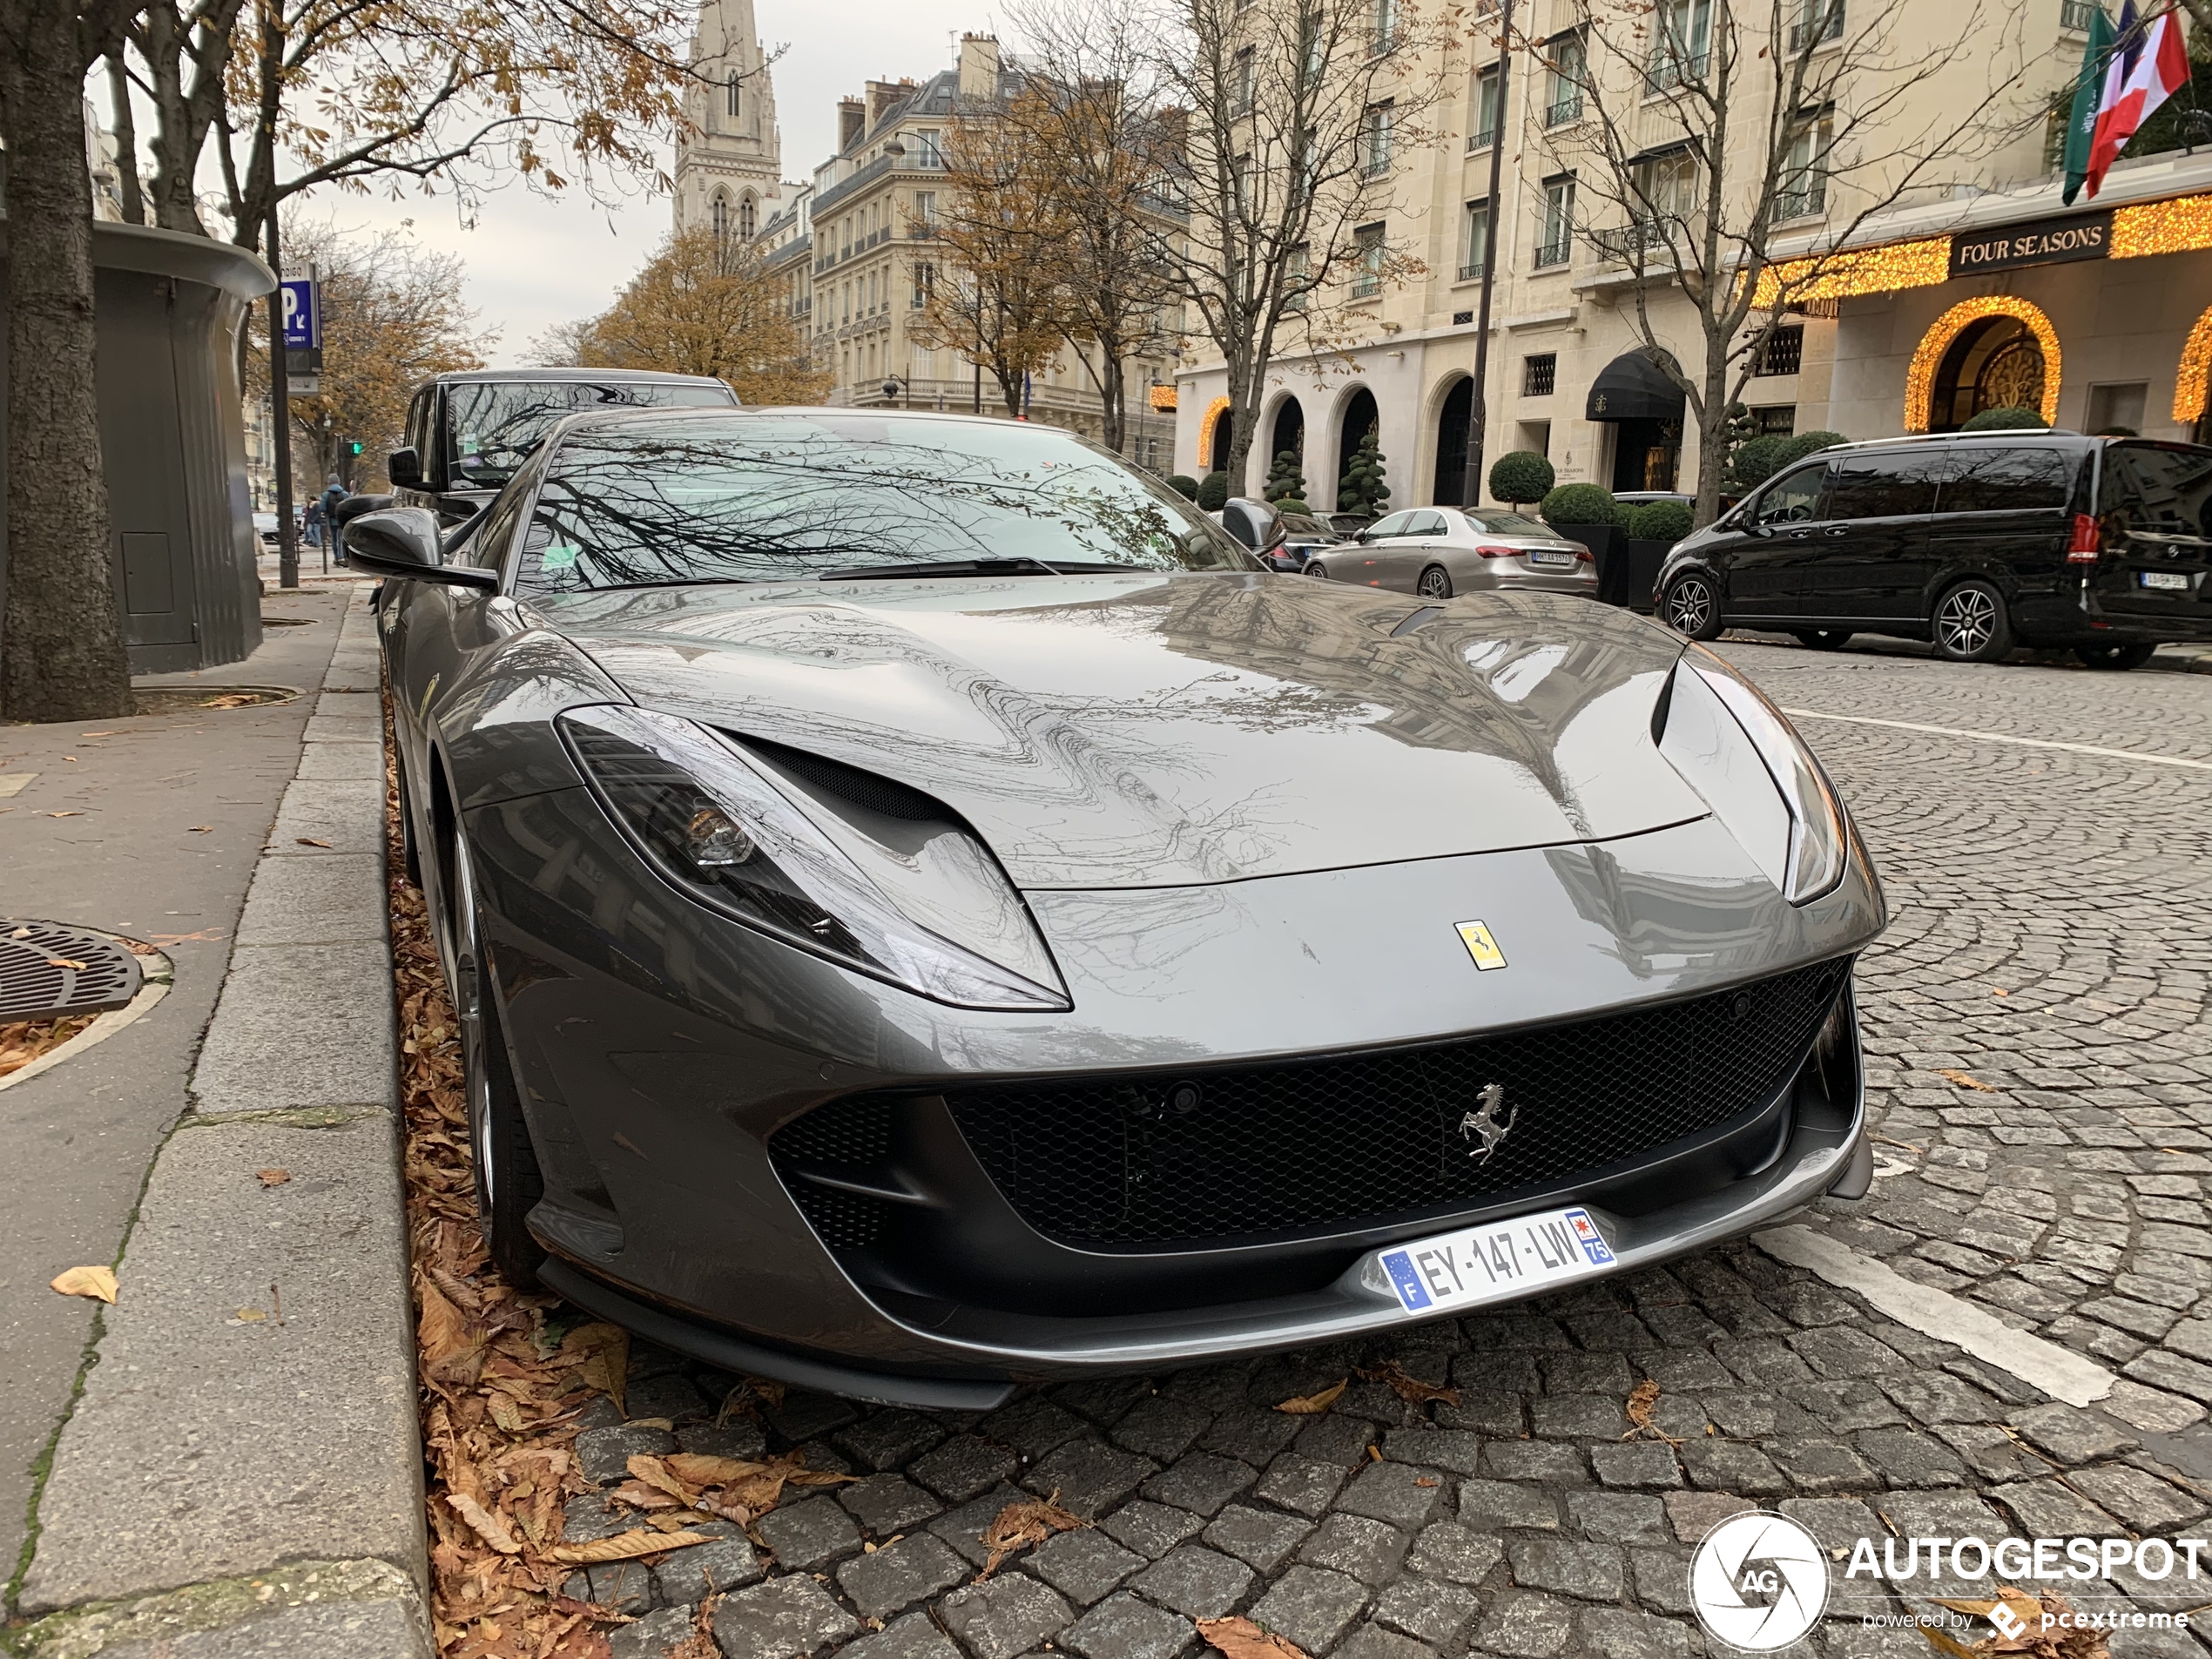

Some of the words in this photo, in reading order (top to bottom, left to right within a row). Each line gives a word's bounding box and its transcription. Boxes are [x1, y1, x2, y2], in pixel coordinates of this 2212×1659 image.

[1960, 239, 2010, 265] FOUR
[2013, 226, 2103, 258] SEASONS
[280, 267, 301, 277] NDIGO
[280, 287, 298, 330] P
[1404, 1282, 1418, 1302] F
[1415, 1221, 1579, 1297] EY-147-LW
[1583, 1241, 1609, 1261] 75
